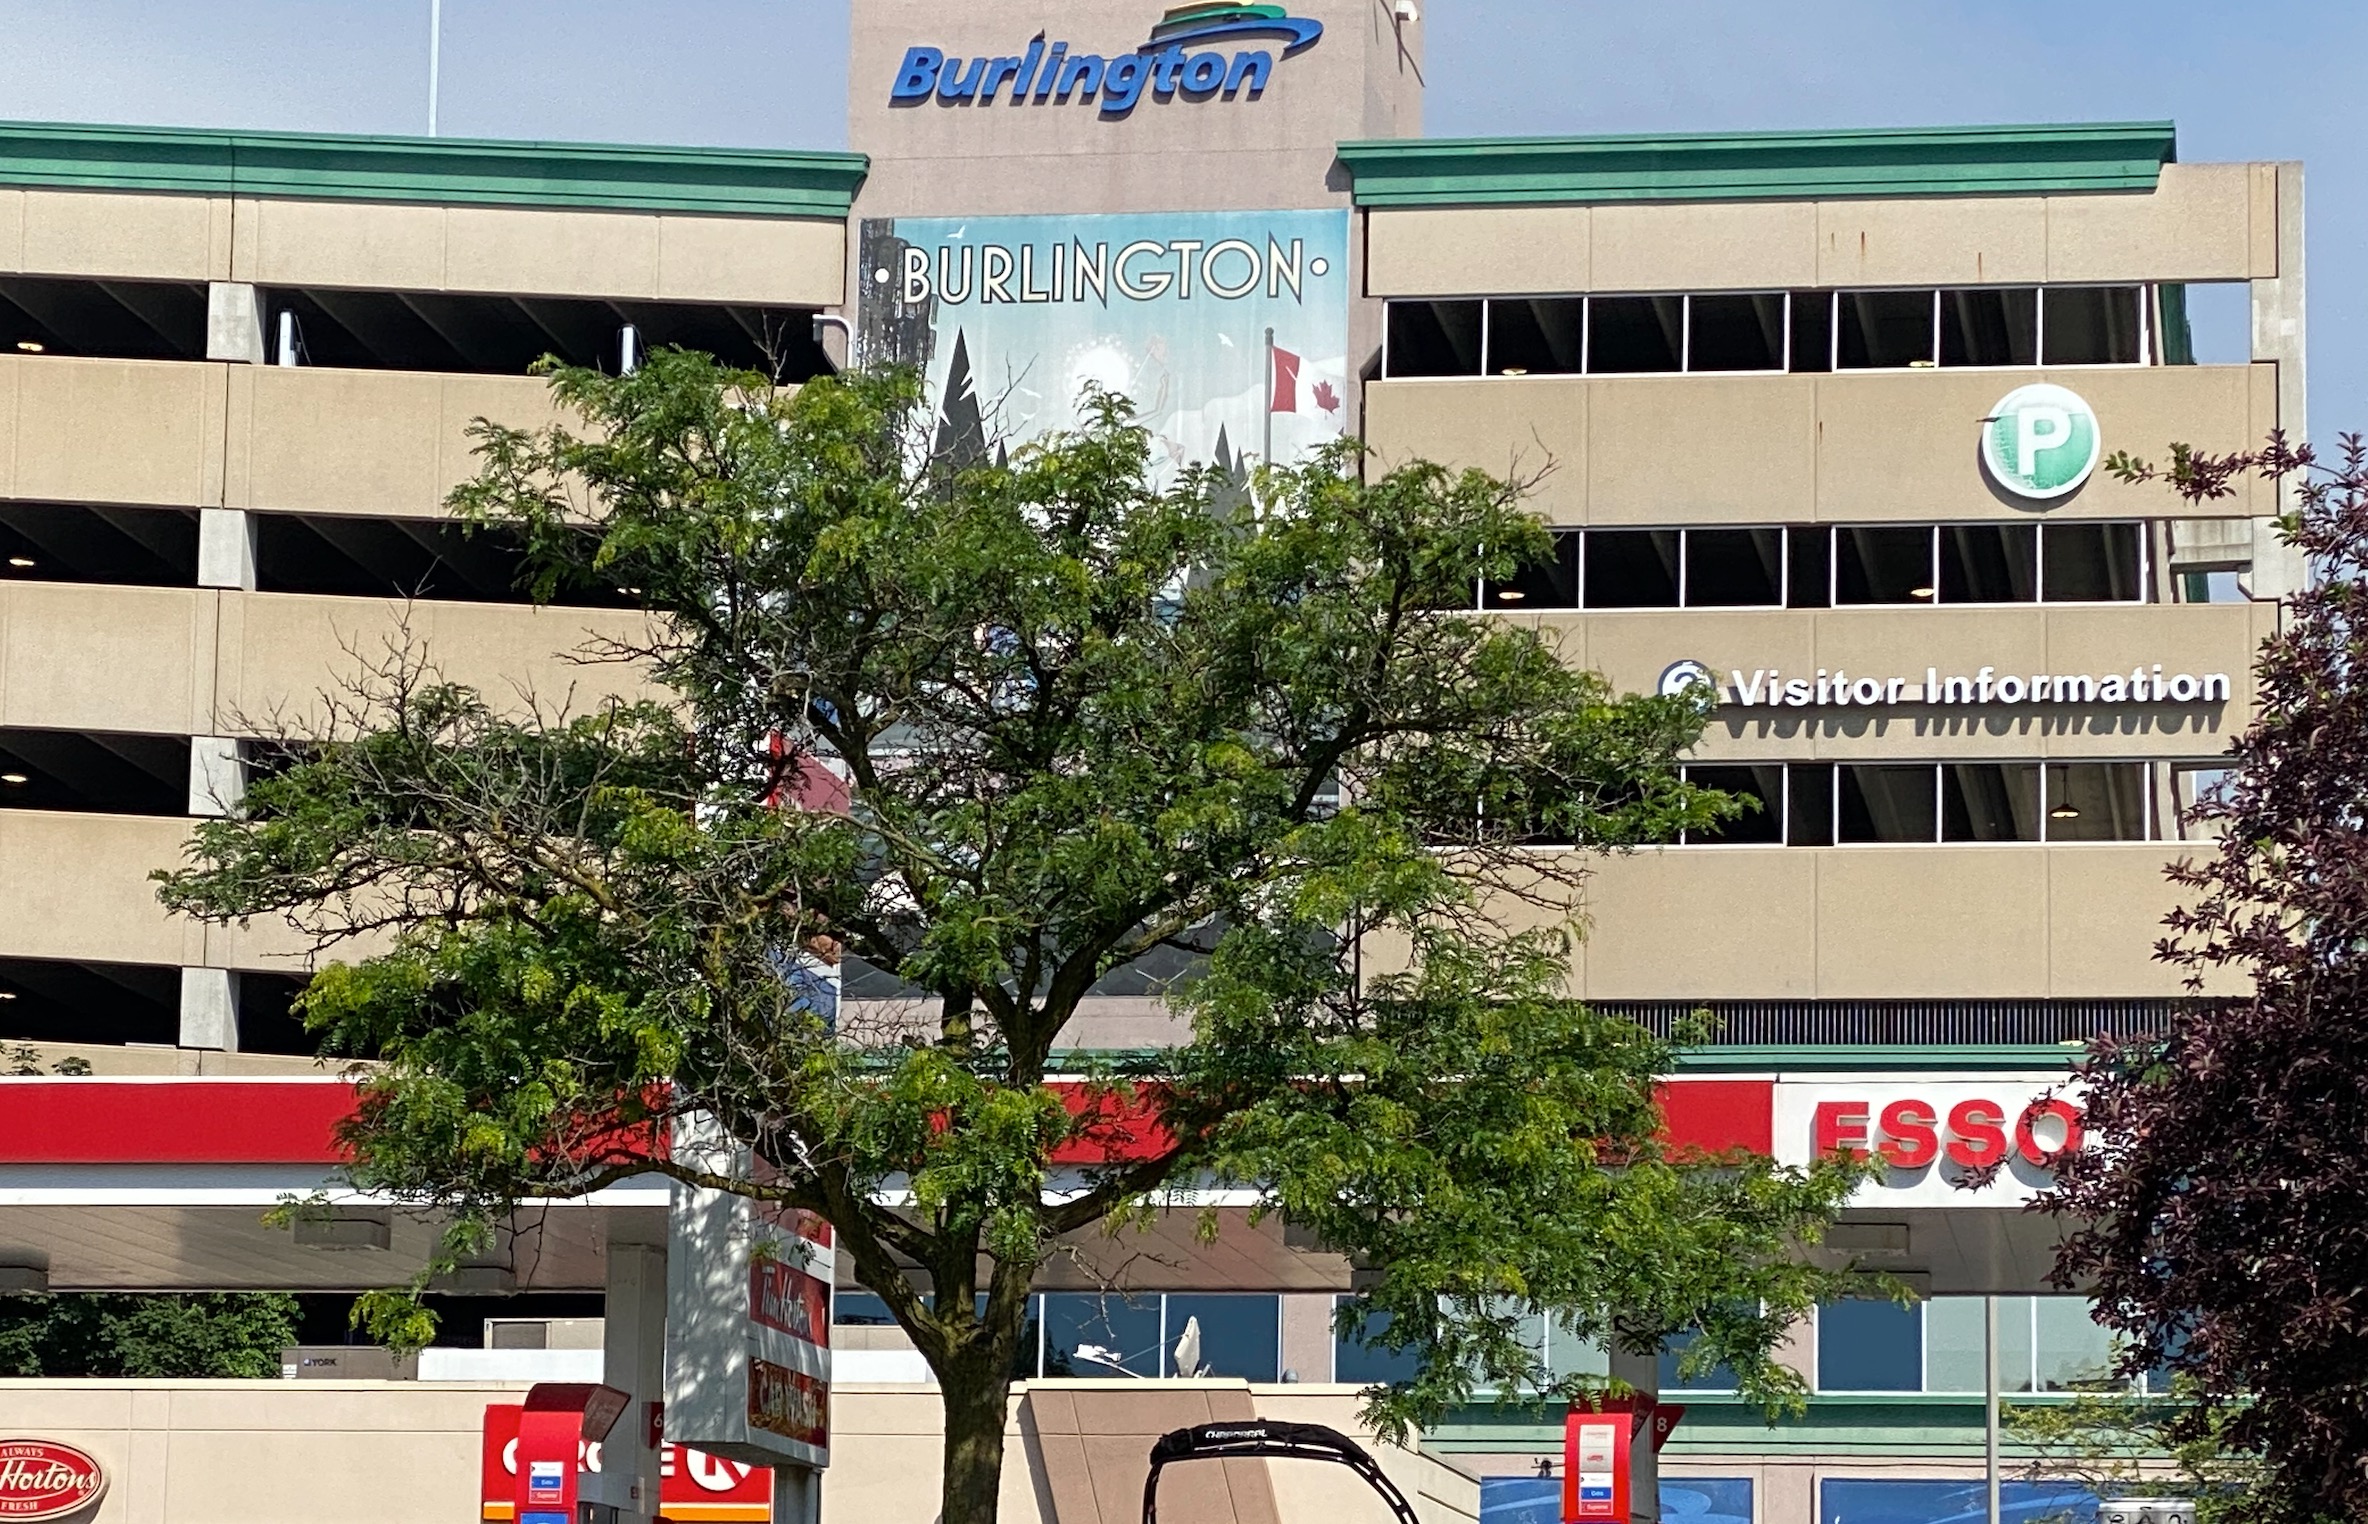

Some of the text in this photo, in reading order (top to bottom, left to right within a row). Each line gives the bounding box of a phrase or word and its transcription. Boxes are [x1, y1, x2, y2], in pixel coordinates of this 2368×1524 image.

[891, 40, 1273, 112] Burlington
[902, 230, 1303, 309] BURLINGTON
[2017, 406, 2072, 475] P
[1731, 664, 2232, 707] Visitor Information
[1815, 1098, 2084, 1169] ESSO
[653, 1413, 663, 1428] 6
[1656, 1416, 1668, 1432] 8
[0, 1447, 44, 1458] ALWAYS
[0, 1459, 97, 1491] Hortons
[0, 1501, 39, 1512] FRESH
